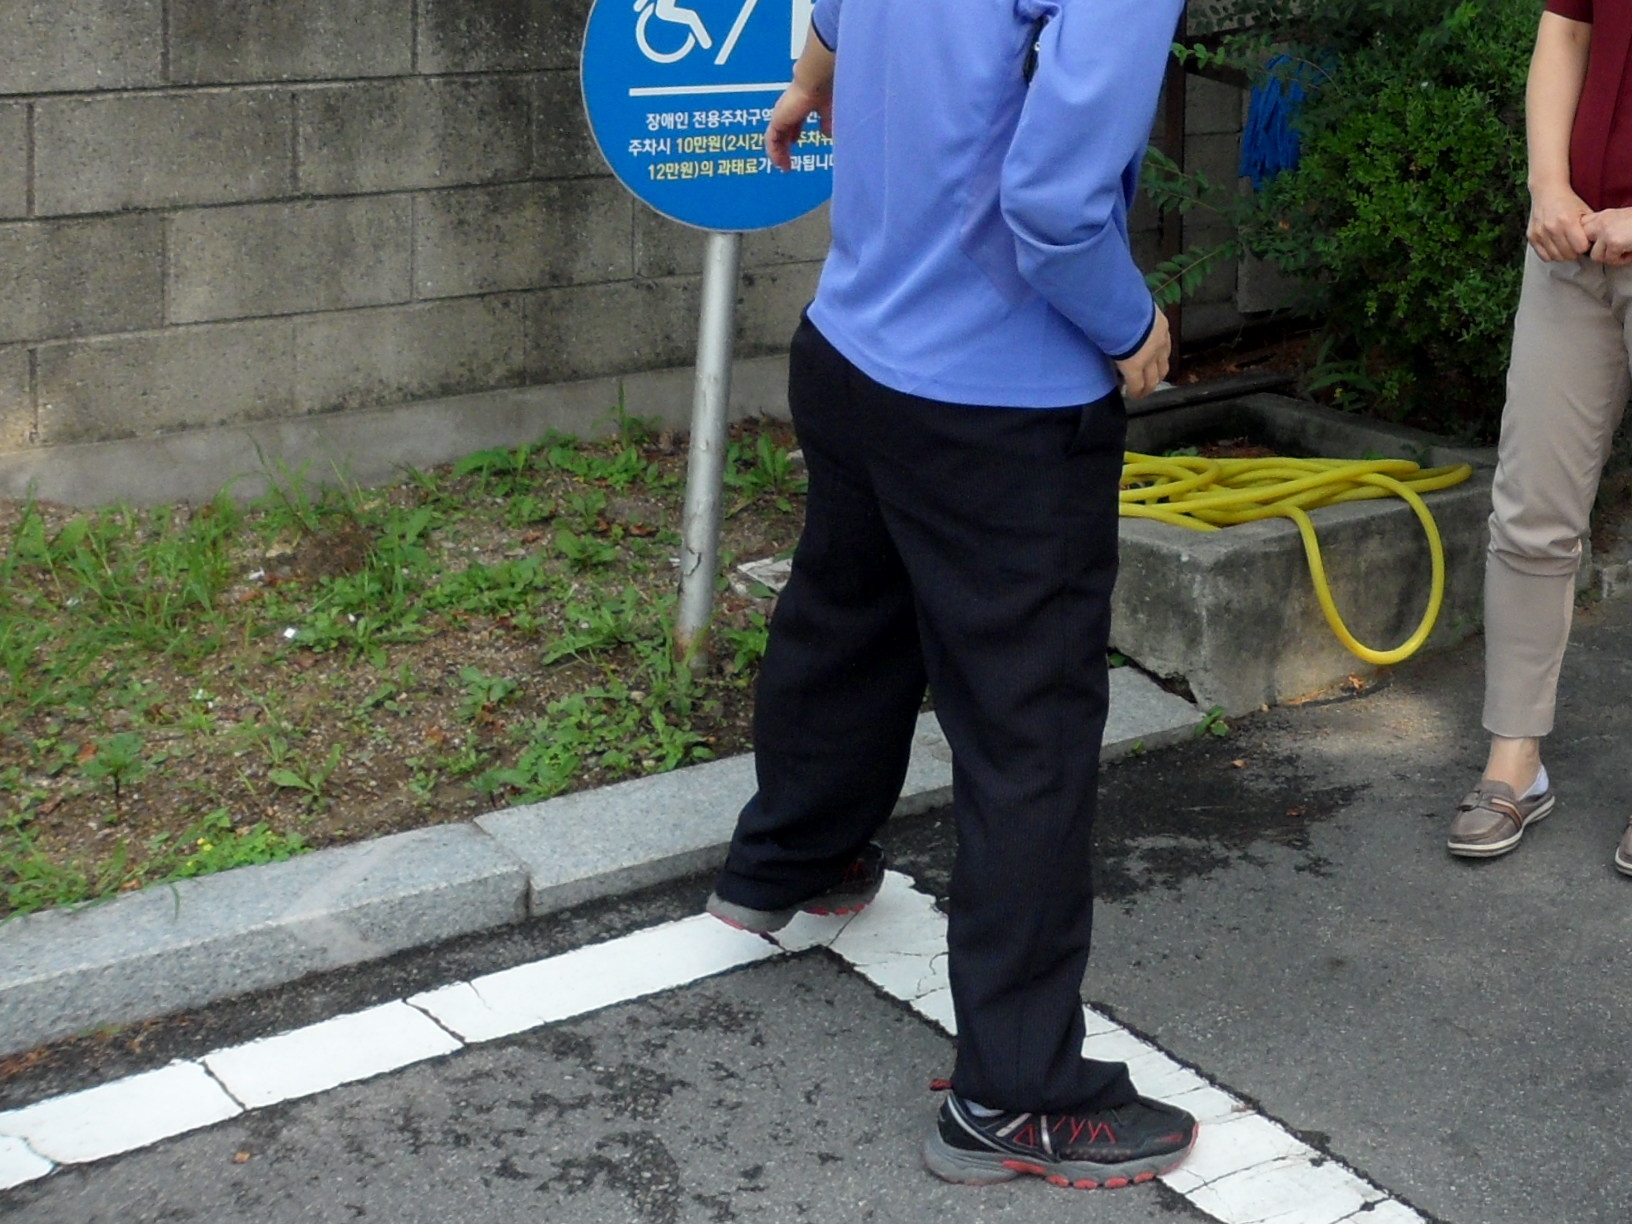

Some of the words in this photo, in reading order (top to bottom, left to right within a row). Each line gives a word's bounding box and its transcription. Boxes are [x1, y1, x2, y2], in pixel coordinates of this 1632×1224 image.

[646, 112, 689, 131] 장애인
[628, 137, 671, 156] 주차시
[648, 160, 714, 180] 12만원)의
[717, 157, 773, 175] 과태료가
[775, 154, 835, 172] 과됩니
